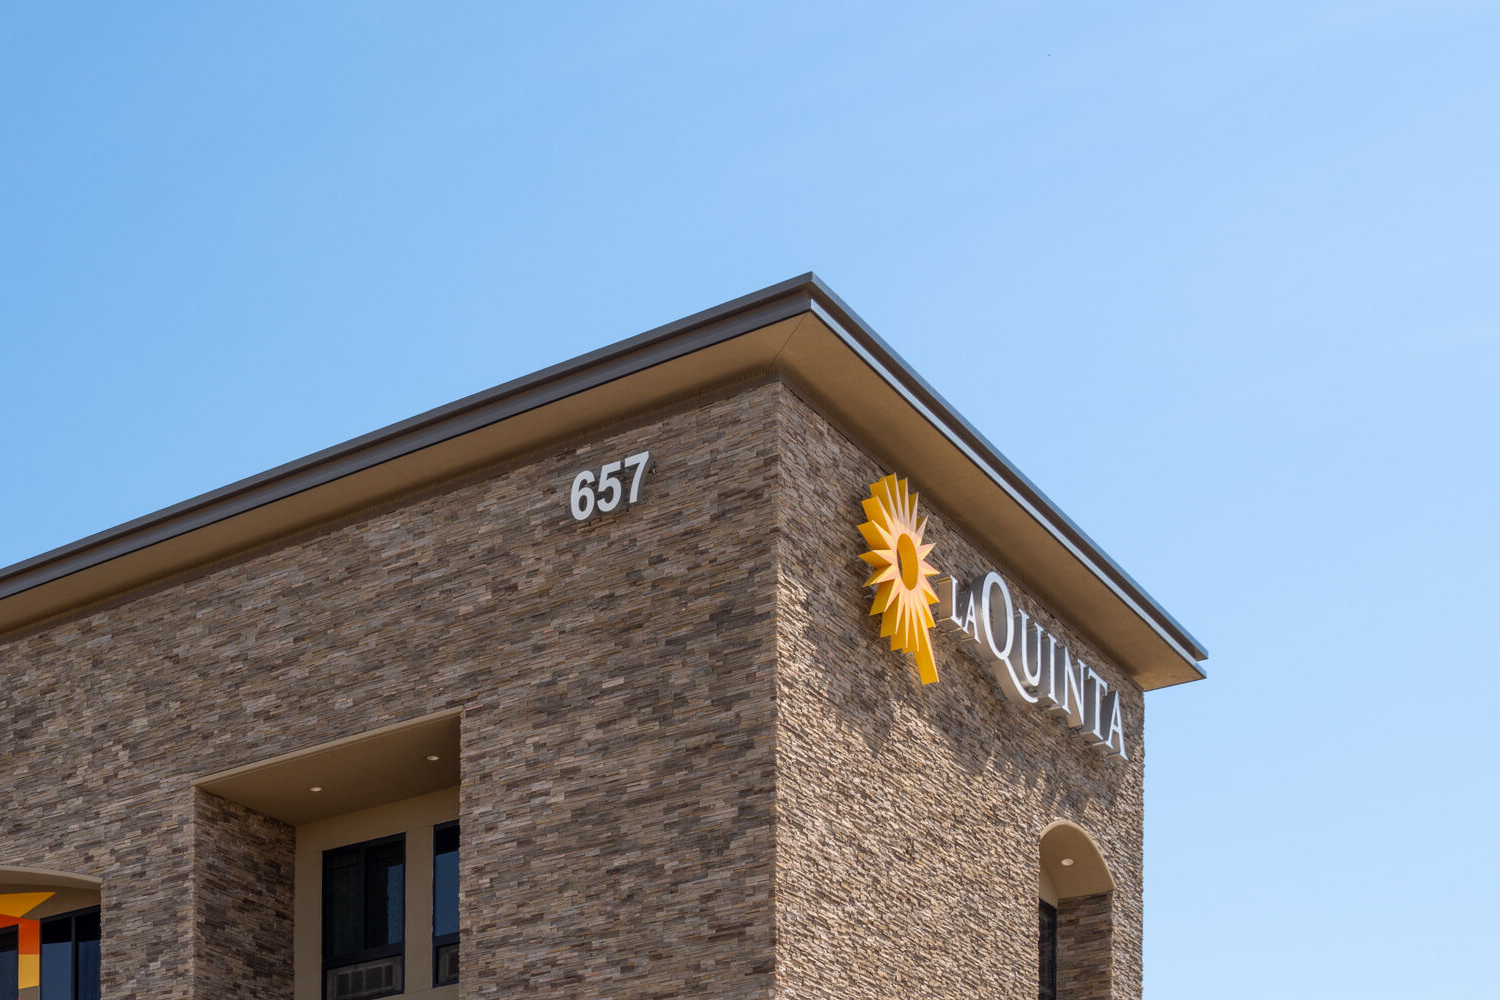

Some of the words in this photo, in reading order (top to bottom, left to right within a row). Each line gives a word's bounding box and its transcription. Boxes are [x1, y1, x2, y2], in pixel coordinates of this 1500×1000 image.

[570, 450, 650, 521] 657
[950, 575, 981, 643] LA
[981, 571, 1129, 761] QUINTA
